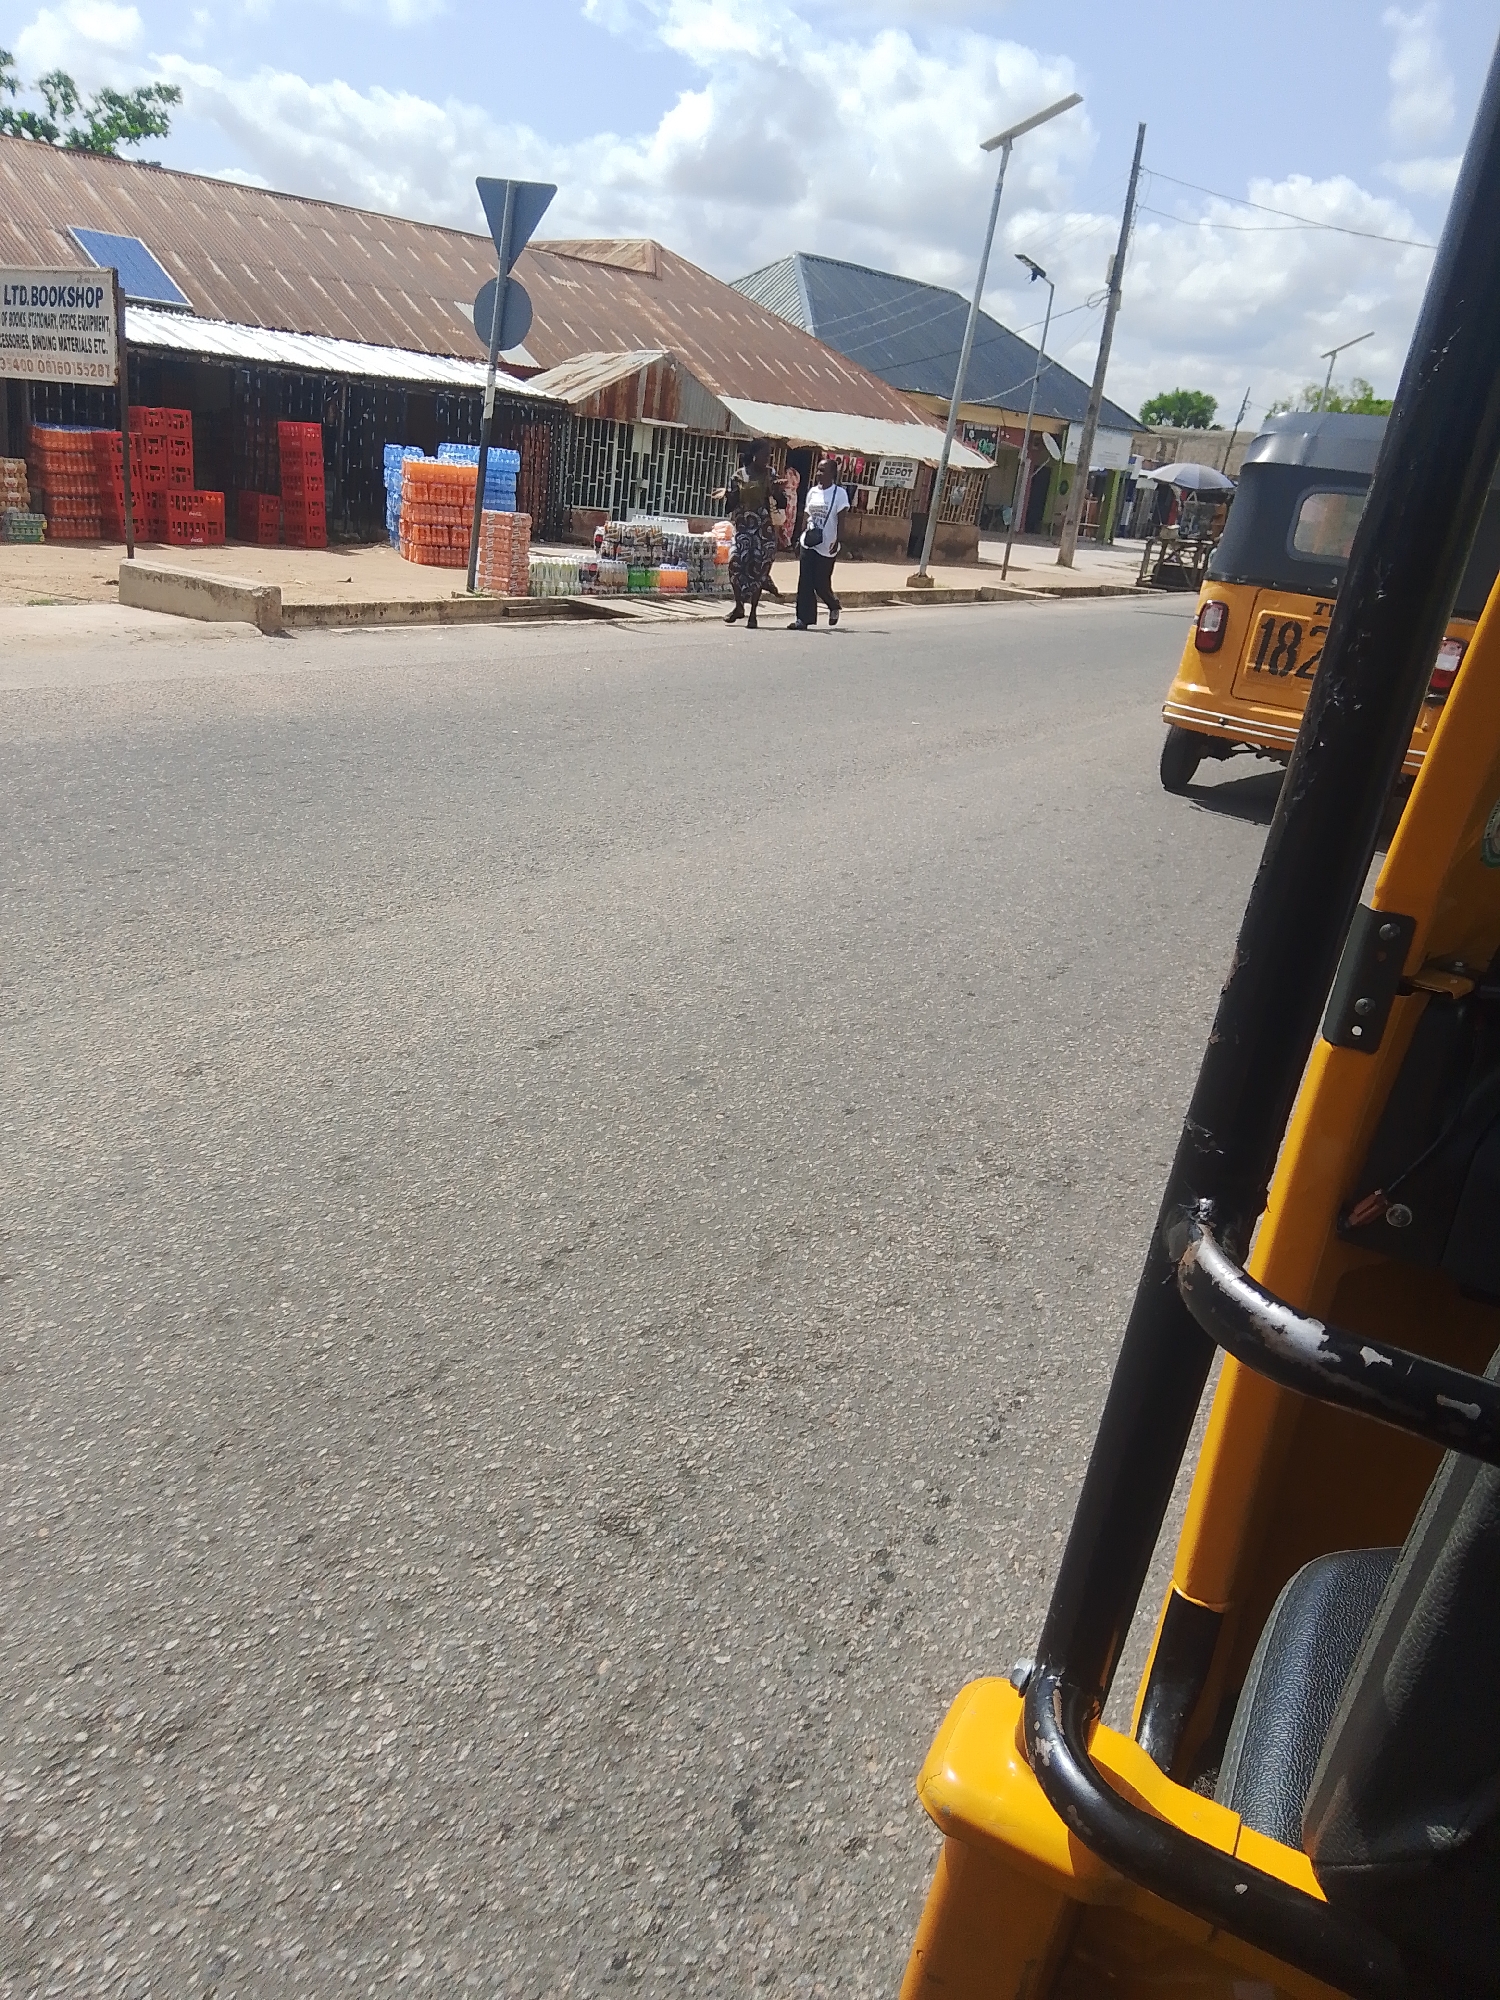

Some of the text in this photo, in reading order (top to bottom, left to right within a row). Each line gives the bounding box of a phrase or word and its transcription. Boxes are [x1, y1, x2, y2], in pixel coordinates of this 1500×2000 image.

[1, 311, 8, 327] OF
[59, 313, 77, 331] OFFICE
[78, 314, 110, 337] EQUIPMENT,
[32, 335, 57, 351] BINDING
[58, 336, 92, 353] MATERIALS
[93, 338, 109, 354] ETC.
[882, 466, 913, 478] DEPOT
